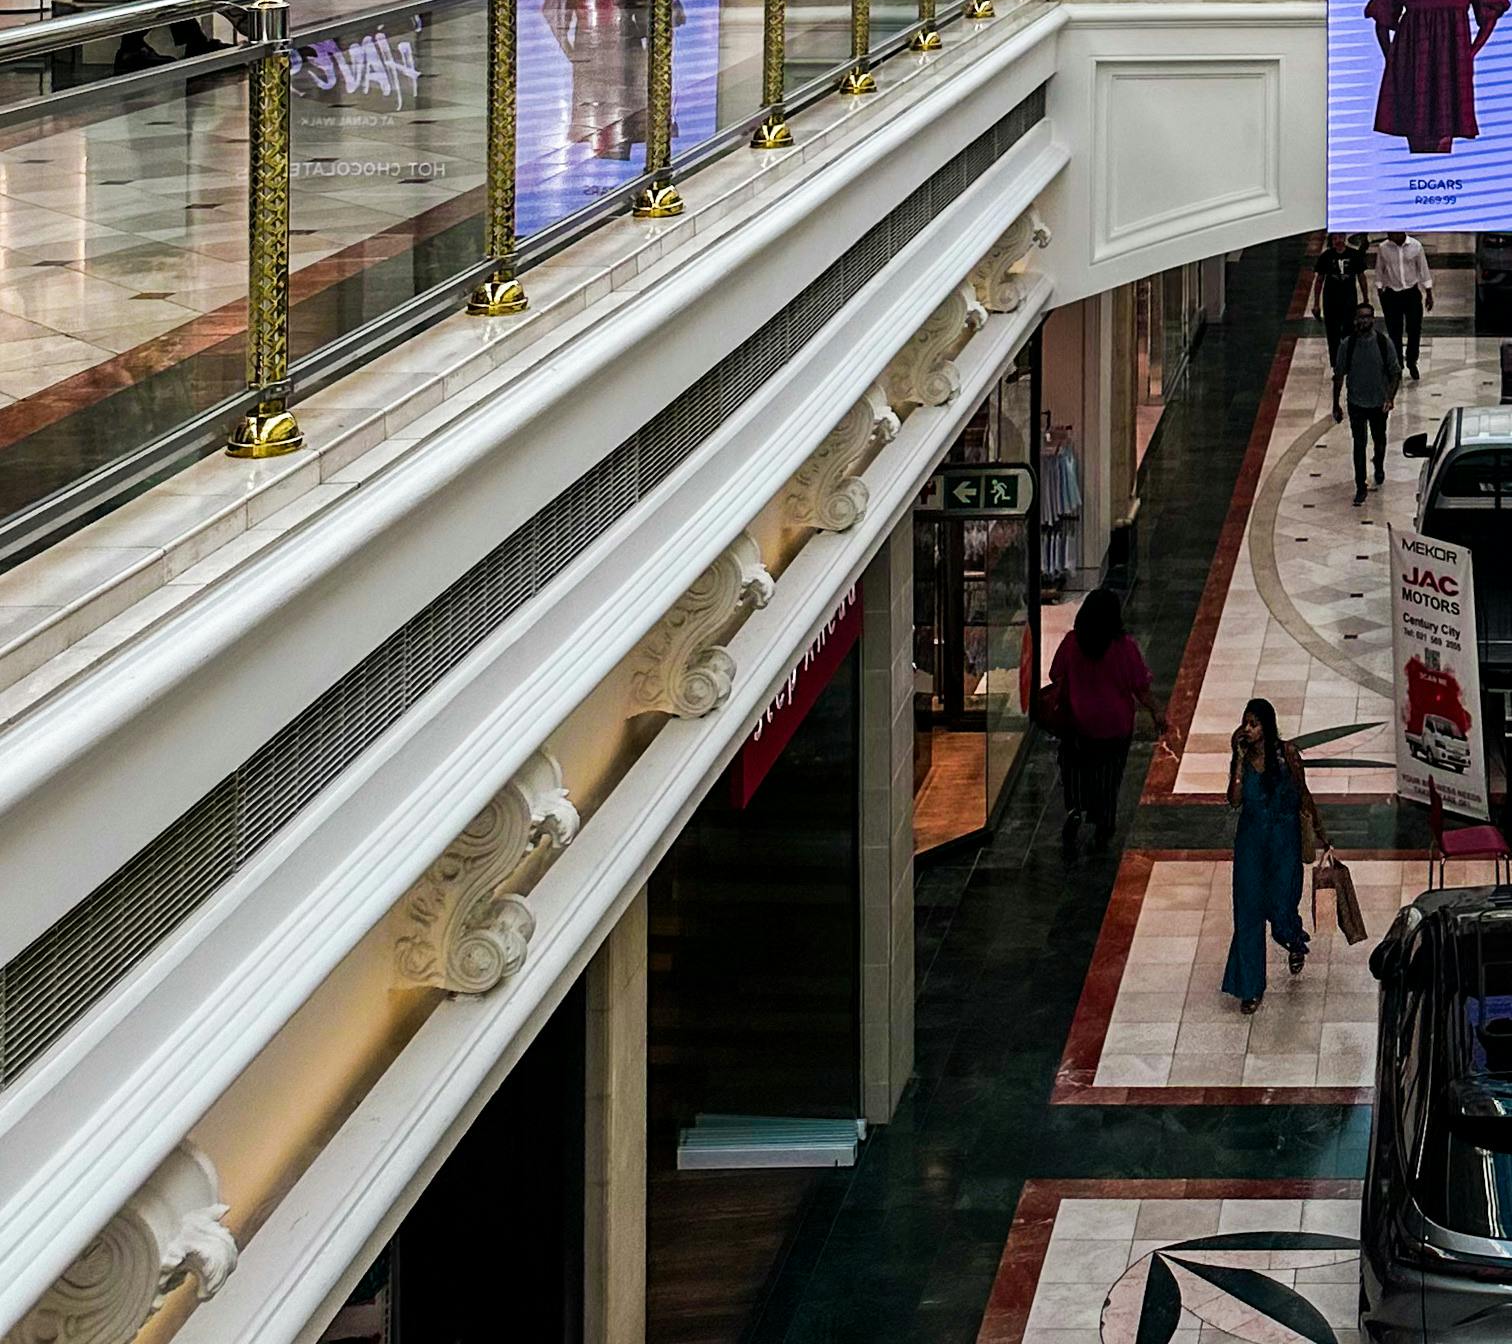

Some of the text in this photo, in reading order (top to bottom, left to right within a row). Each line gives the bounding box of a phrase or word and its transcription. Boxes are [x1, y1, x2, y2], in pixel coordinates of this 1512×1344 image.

[1408, 179, 1463, 191] EDGARS
[1402, 538, 1457, 565] MEKOR
[1402, 567, 1459, 597] JAC
[1402, 587, 1460, 615] MOTORS
[1403, 612, 1461, 640] Century City
